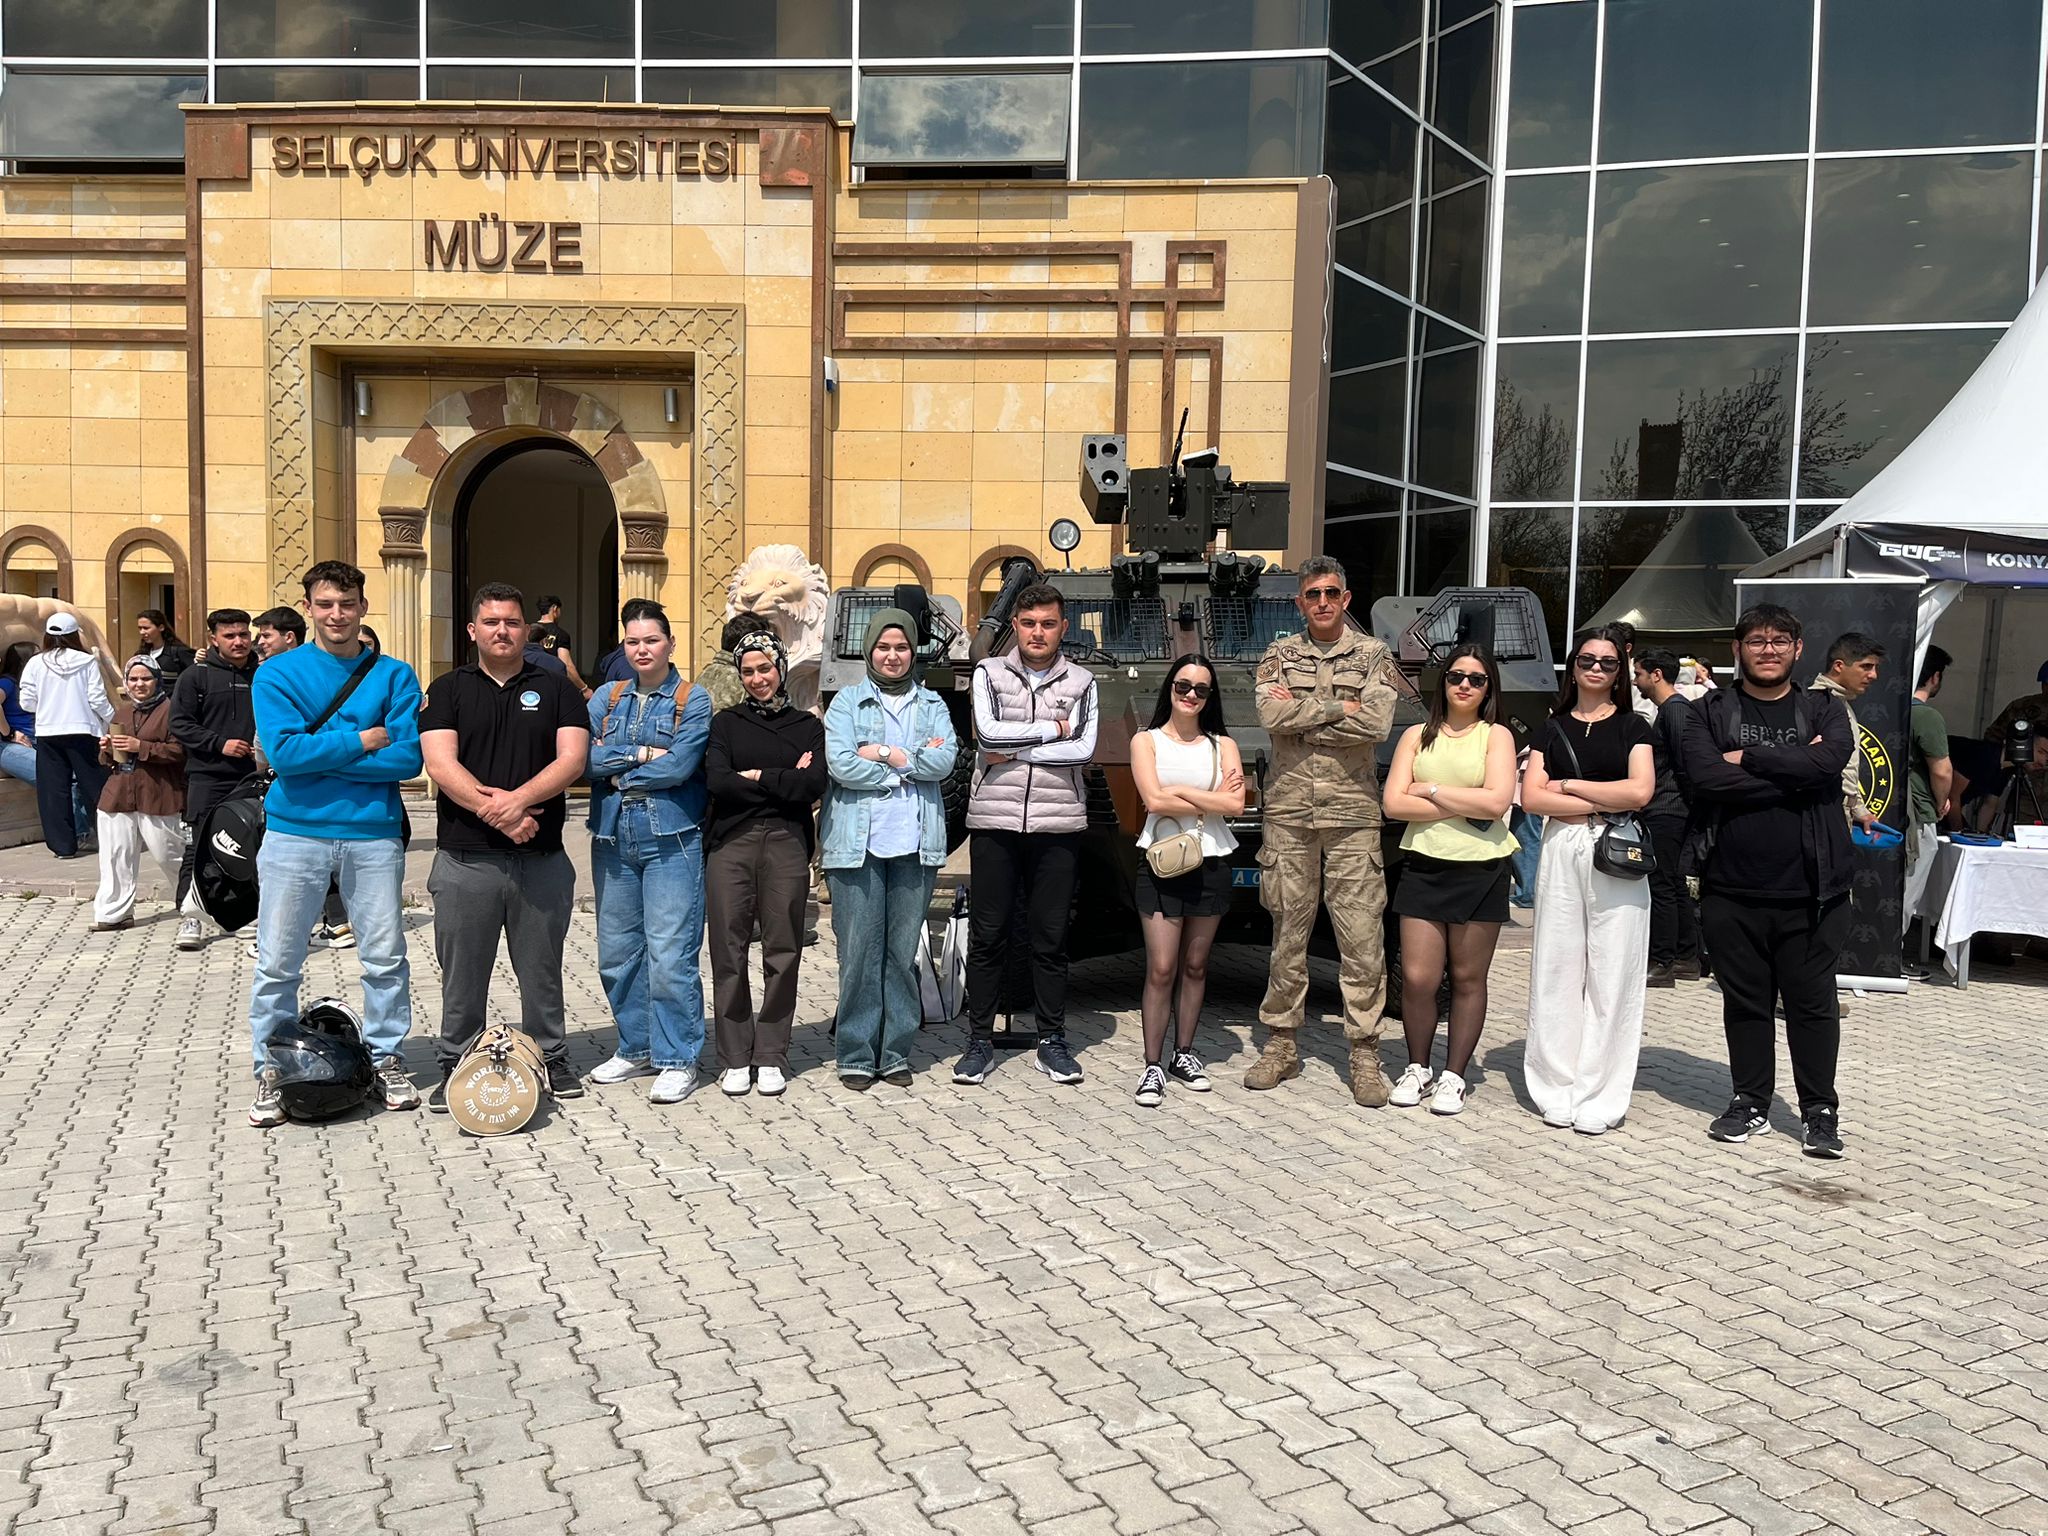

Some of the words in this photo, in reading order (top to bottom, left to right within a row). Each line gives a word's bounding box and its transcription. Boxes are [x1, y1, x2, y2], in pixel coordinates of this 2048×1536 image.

[272, 134, 437, 177] SELÇUK
[455, 128, 738, 175] ÜNİVERSİTESİ
[424, 212, 583, 268] MÜZE
[216, 829, 242, 852] NIKE
[465, 1064, 502, 1089] WORLD
